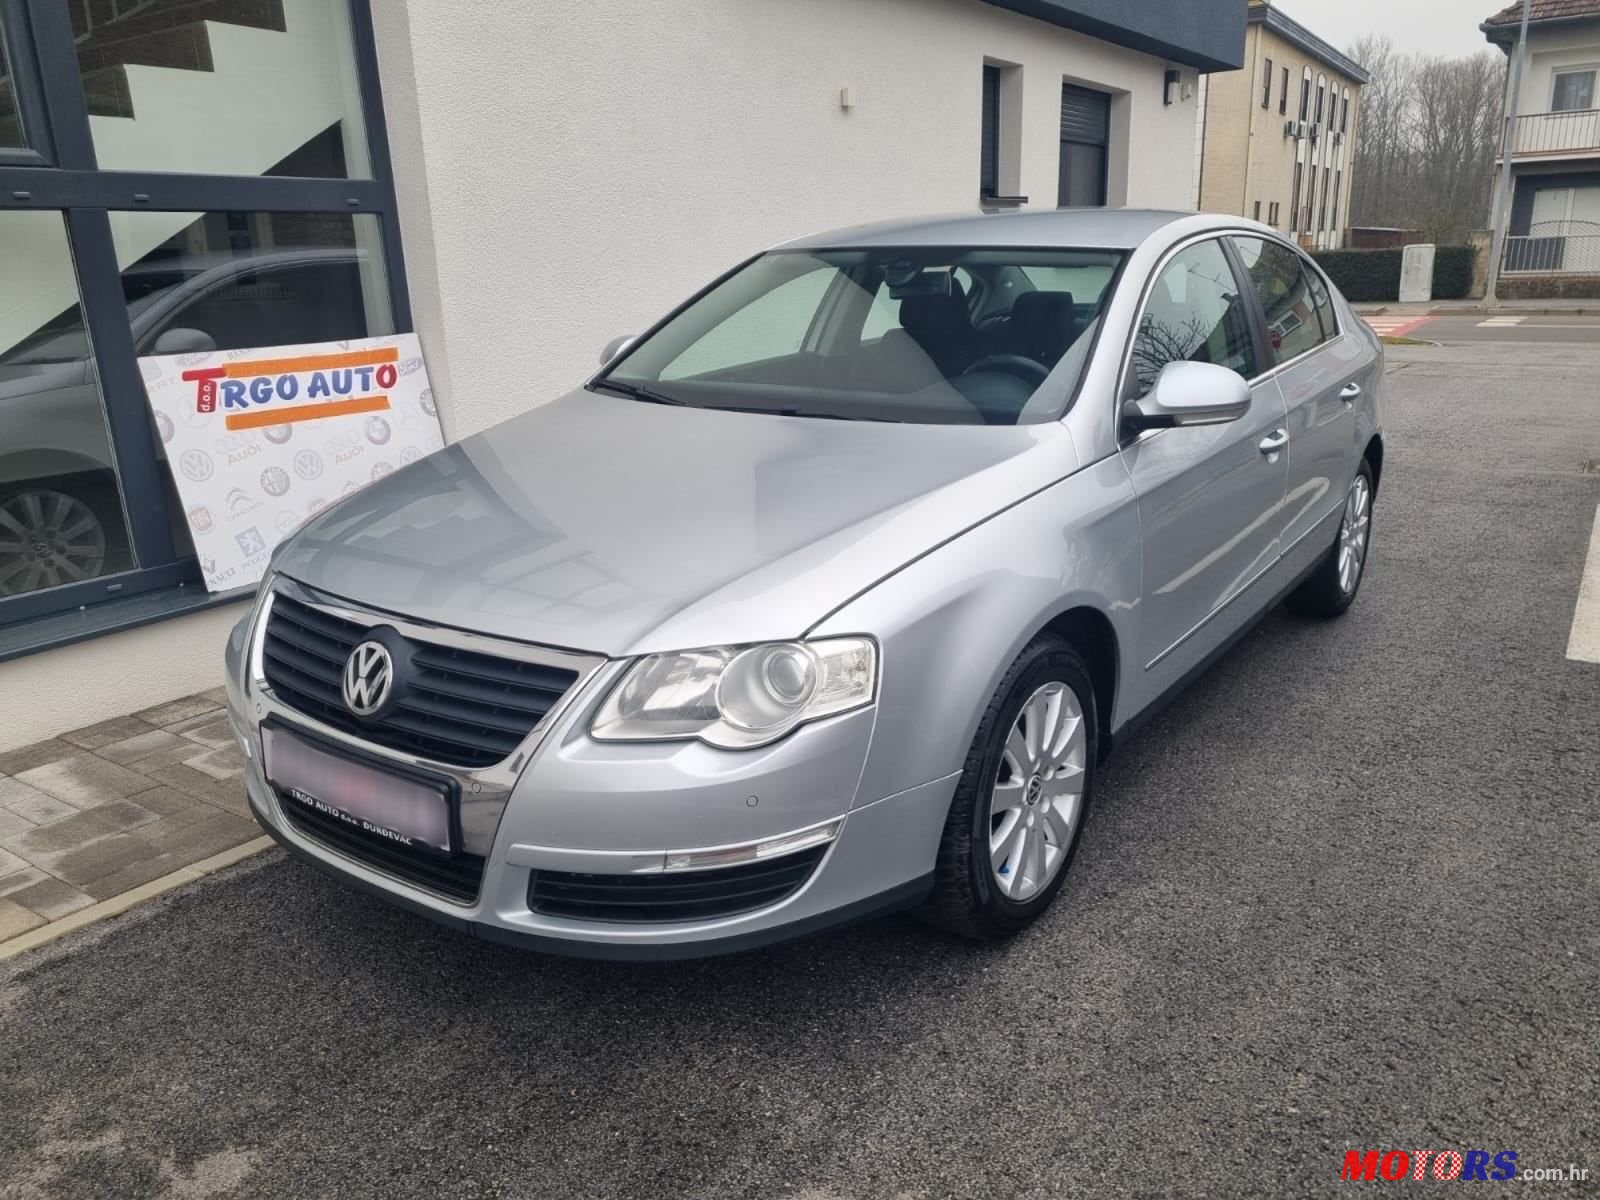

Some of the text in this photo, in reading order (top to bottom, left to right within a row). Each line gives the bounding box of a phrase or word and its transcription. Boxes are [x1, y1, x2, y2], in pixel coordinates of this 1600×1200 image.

[182, 364, 398, 413] TRGO AUTO
[200, 382, 212, 411] d.o.o.
[291, 789, 313, 806] TRGO
[315, 800, 340, 817] AUTO
